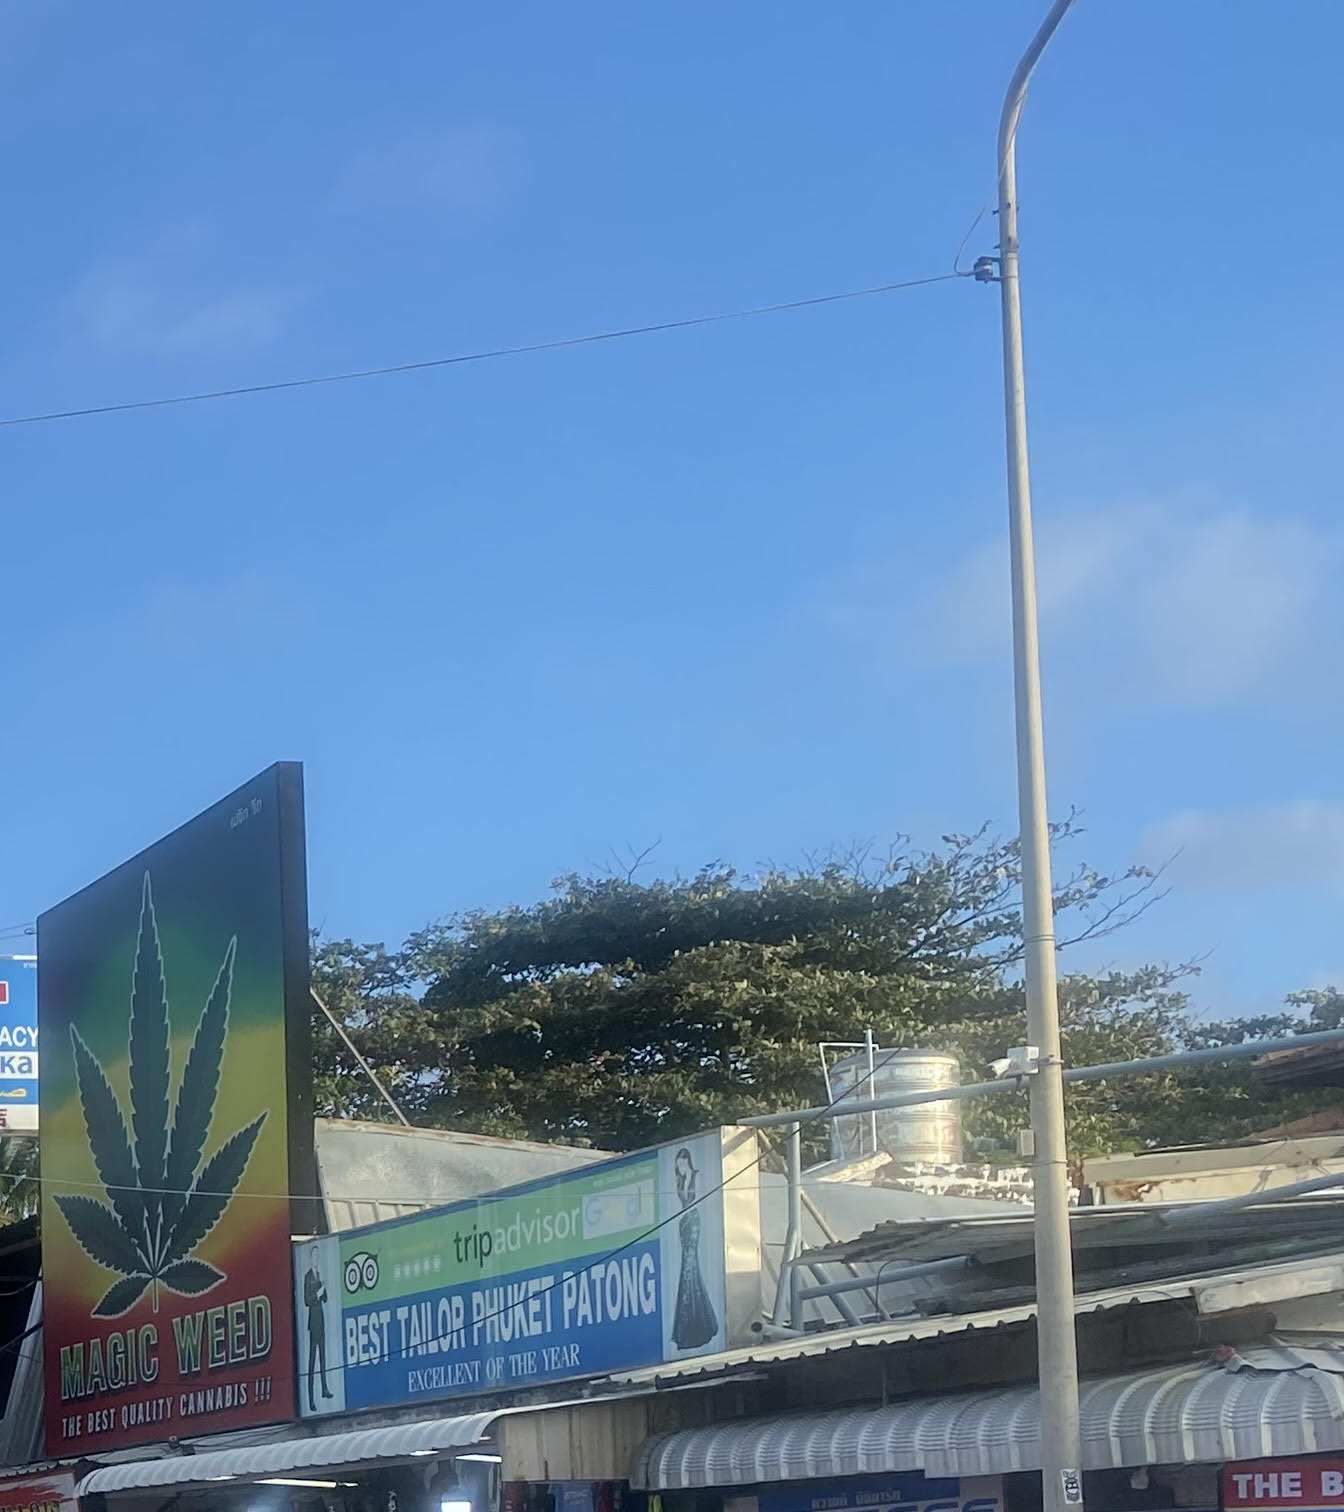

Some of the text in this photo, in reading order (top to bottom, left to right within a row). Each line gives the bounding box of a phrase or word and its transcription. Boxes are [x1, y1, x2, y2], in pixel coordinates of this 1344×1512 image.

[454, 1206, 581, 1268] tripadvisor
[346, 1252, 657, 1369] BEST TAILOR PHUKET PATONG
[61, 1294, 272, 1401] MAGIC WEED
[408, 1343, 580, 1393] EXCELLENT OF THE YEAR
[63, 1376, 272, 1438] THE BEST QUALITY CANNABIS !!!
[1232, 1471, 1303, 1499] THE
